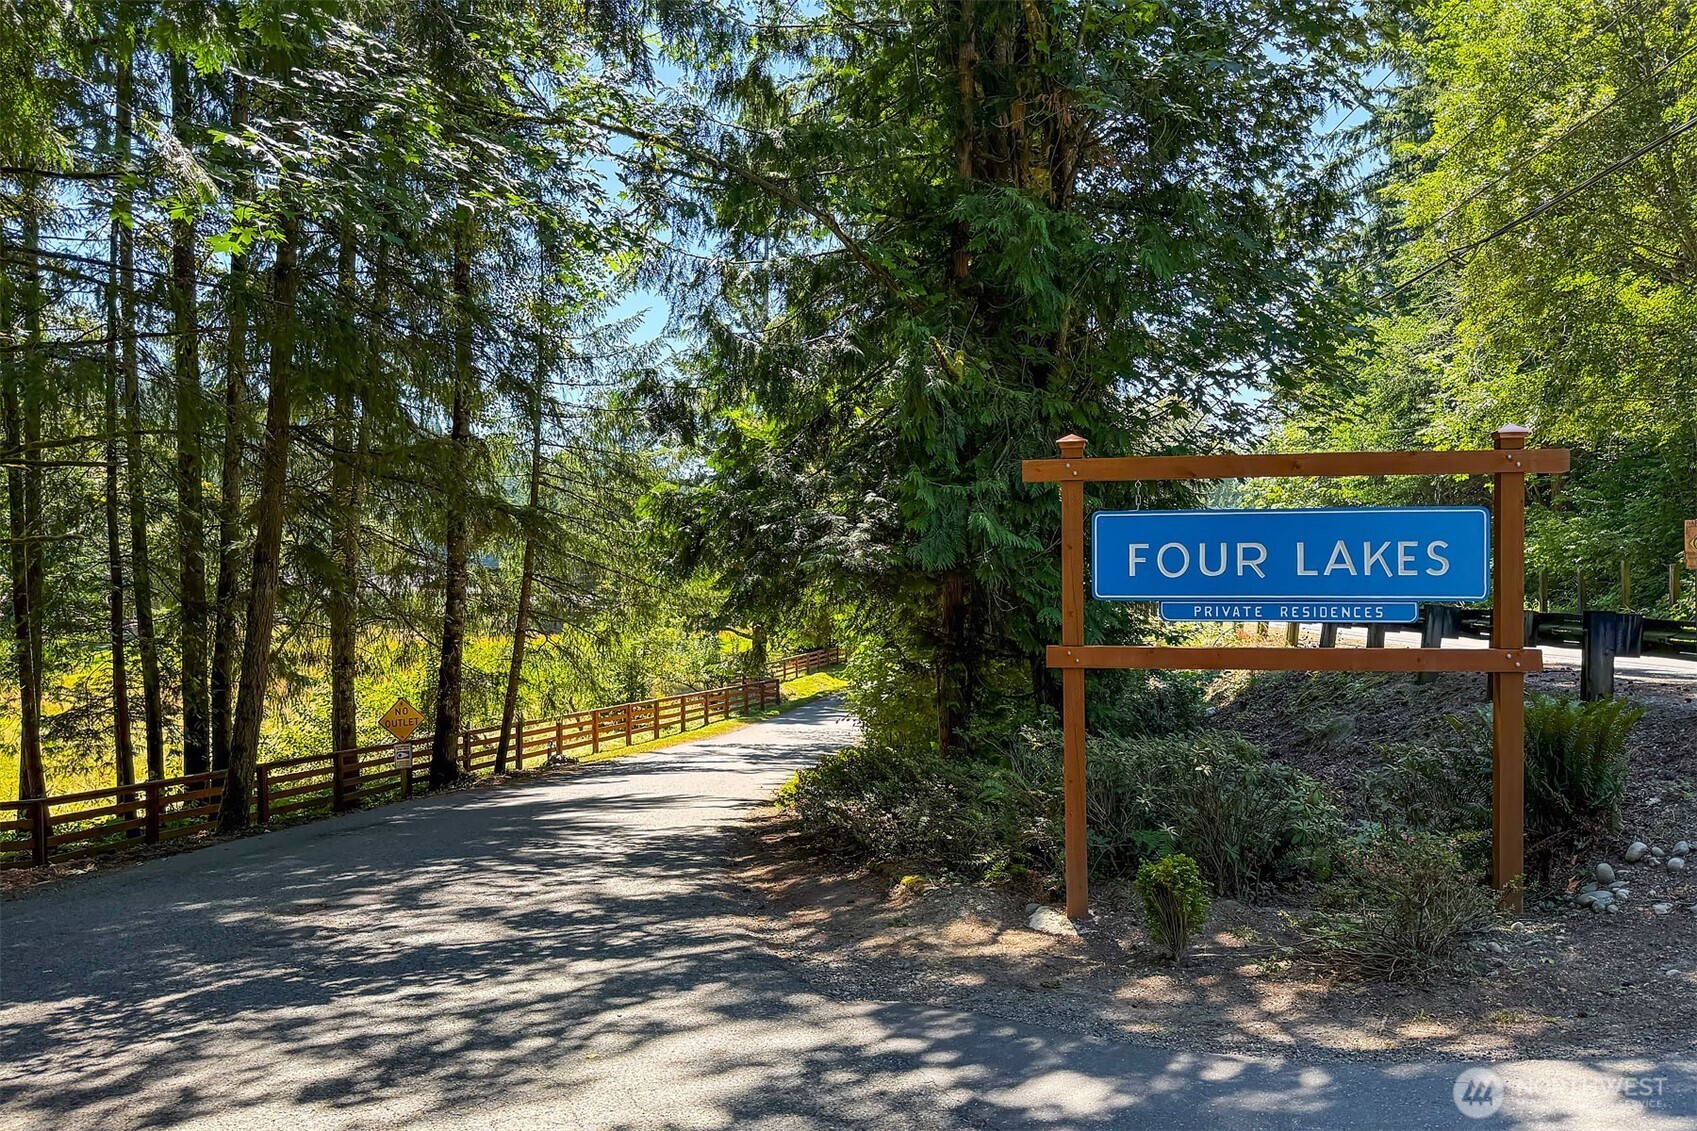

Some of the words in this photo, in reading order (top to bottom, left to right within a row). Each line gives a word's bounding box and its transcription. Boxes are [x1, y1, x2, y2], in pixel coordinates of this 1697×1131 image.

[1128, 542, 1268, 579] FOUR
[1296, 540, 1451, 578] LAKES
[1193, 606, 1263, 618] PRIVATE
[1280, 606, 1384, 618] RESIDENCES
[394, 707, 409, 716] NO
[384, 717, 419, 729] OUTLET
